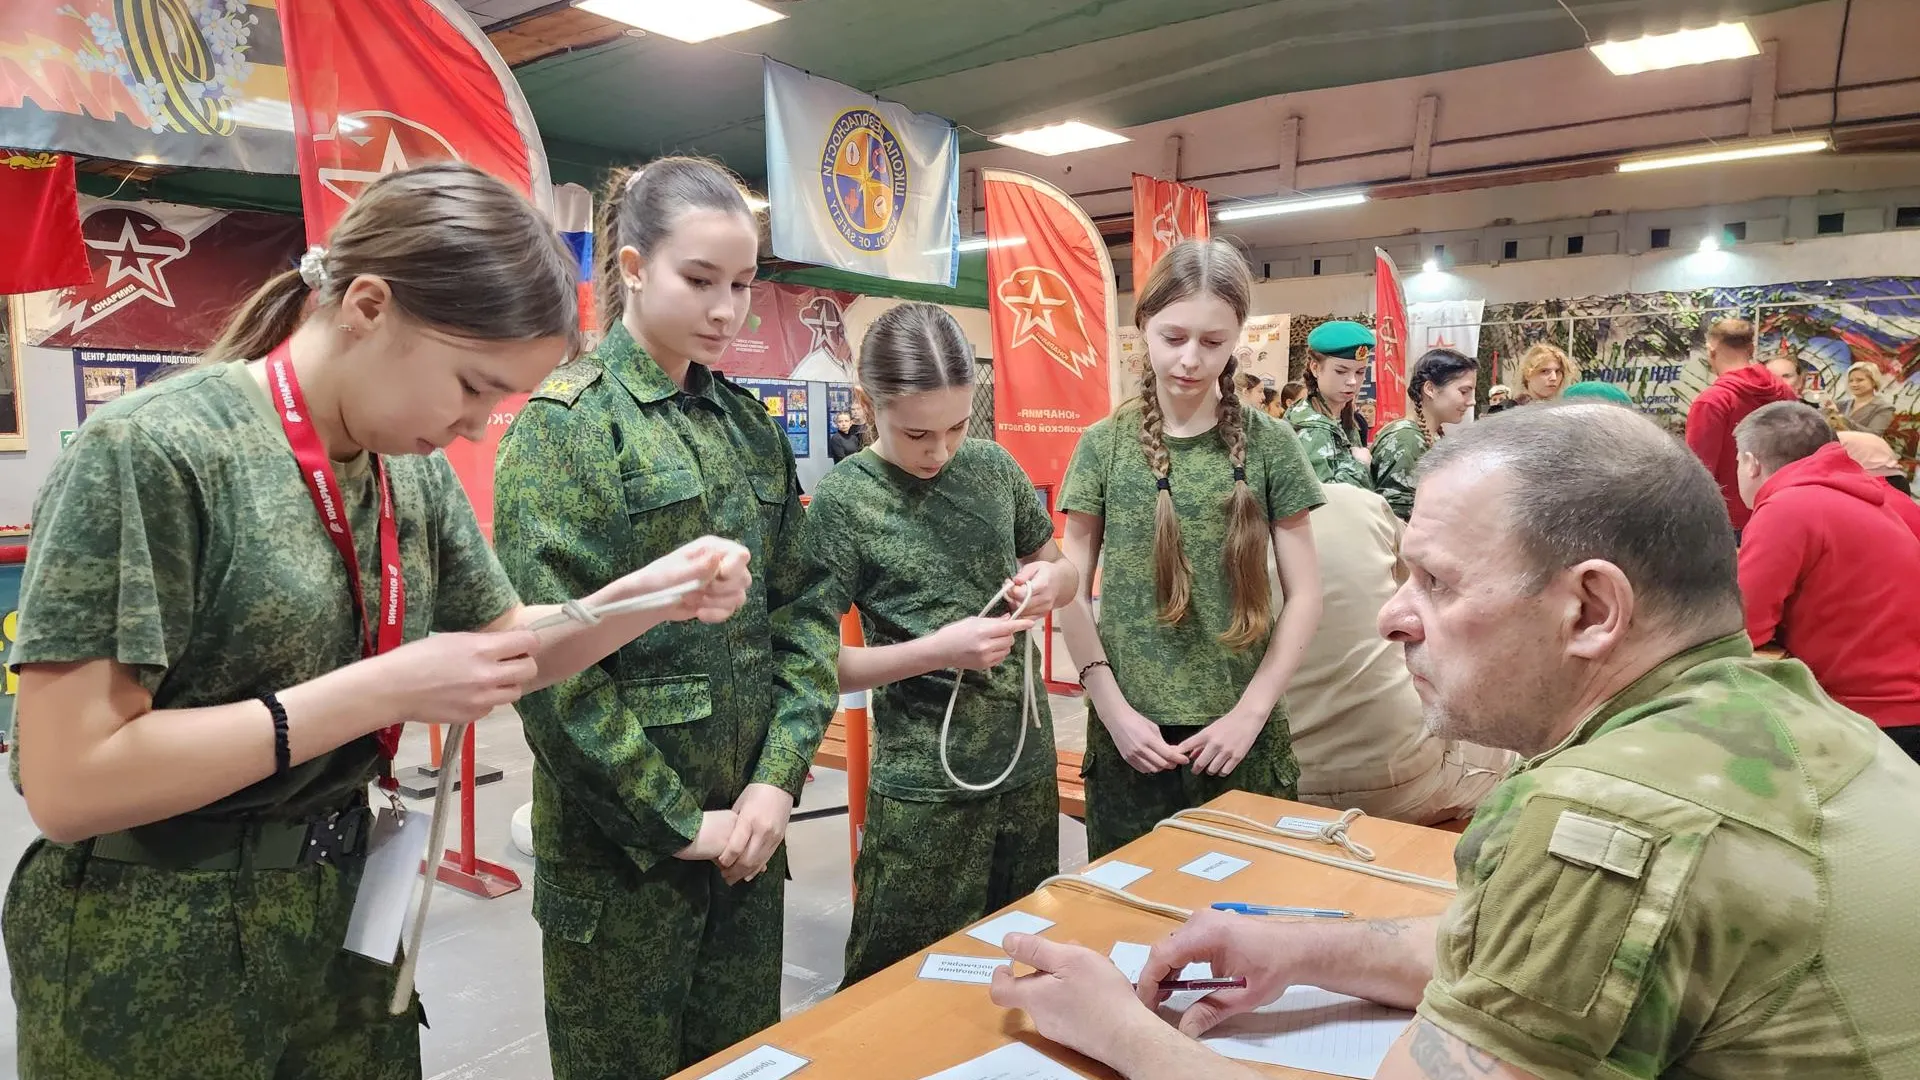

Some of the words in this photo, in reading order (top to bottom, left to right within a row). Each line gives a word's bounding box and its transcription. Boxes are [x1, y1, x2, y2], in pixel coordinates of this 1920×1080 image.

[91, 283, 137, 313] ЮНАРМИЯ
[81, 351, 106, 361] ЦЕНТР
[106, 352, 162, 364] ДОПРИЗЫВНОЙ
[162, 354, 202, 365] ПОДГОТОВК
[312, 470, 337, 521] ЮНАРМИЯ
[387, 577, 399, 626] ЮНАРМИЯ
